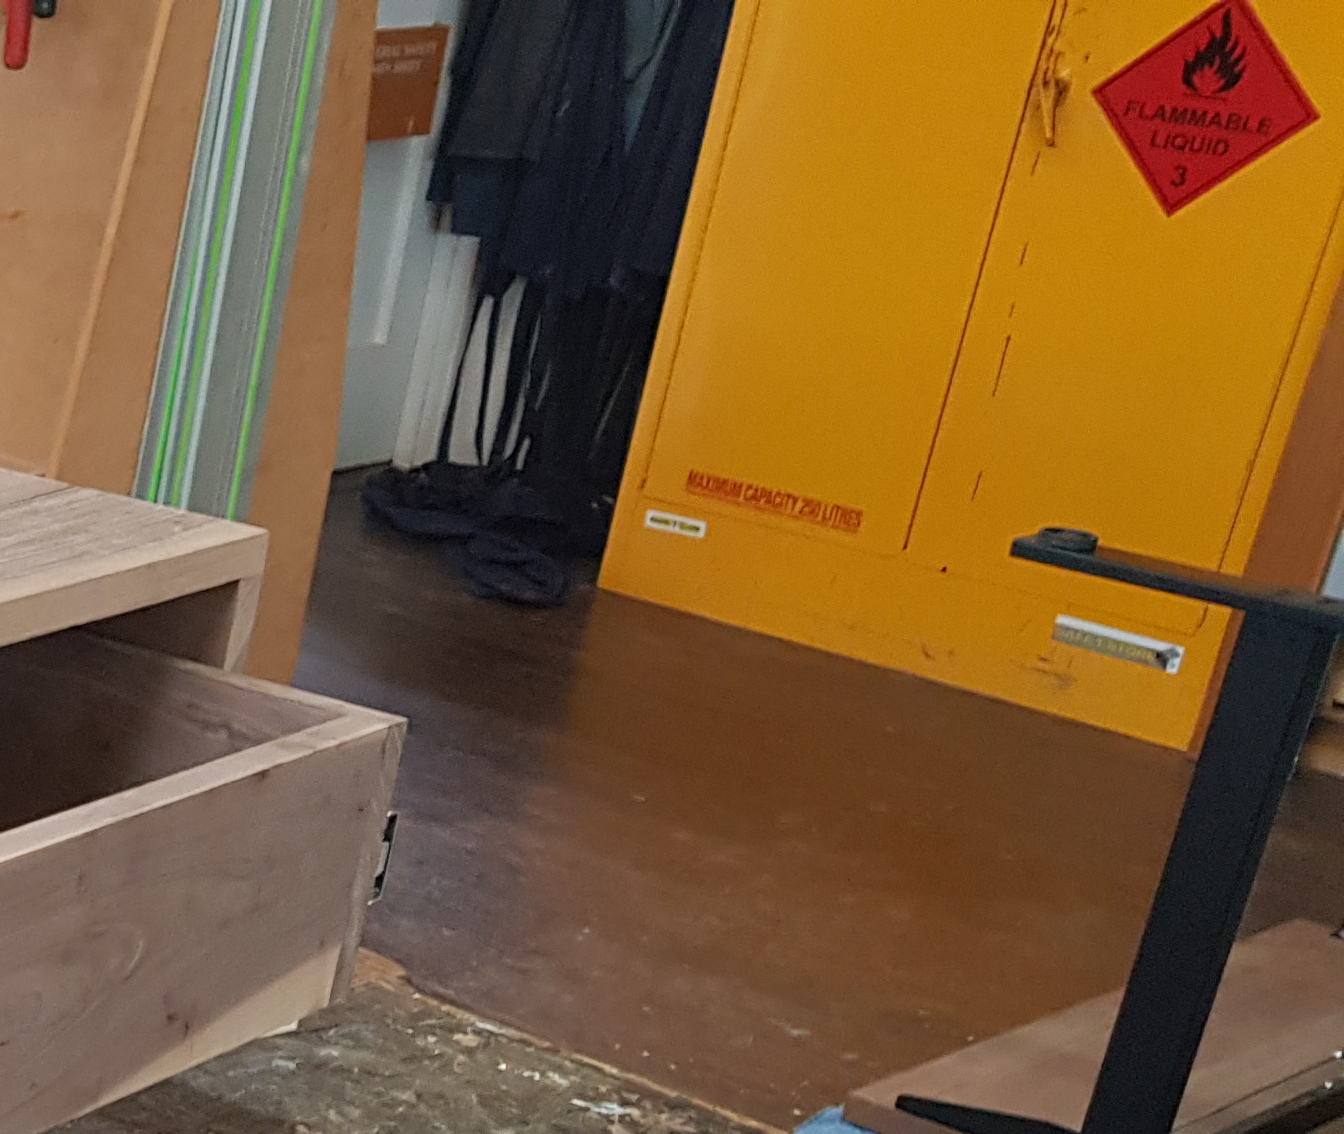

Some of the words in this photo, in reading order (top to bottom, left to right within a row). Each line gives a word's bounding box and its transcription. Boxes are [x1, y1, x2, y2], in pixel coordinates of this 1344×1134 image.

[1123, 99, 1273, 135] FLAMMABLE
[1150, 129, 1231, 157] LIQUID
[1170, 164, 1189, 188] 3
[686, 469, 743, 501] MAXIMUM
[742, 482, 801, 515] CAPACITY
[821, 502, 864, 532] LITRES
